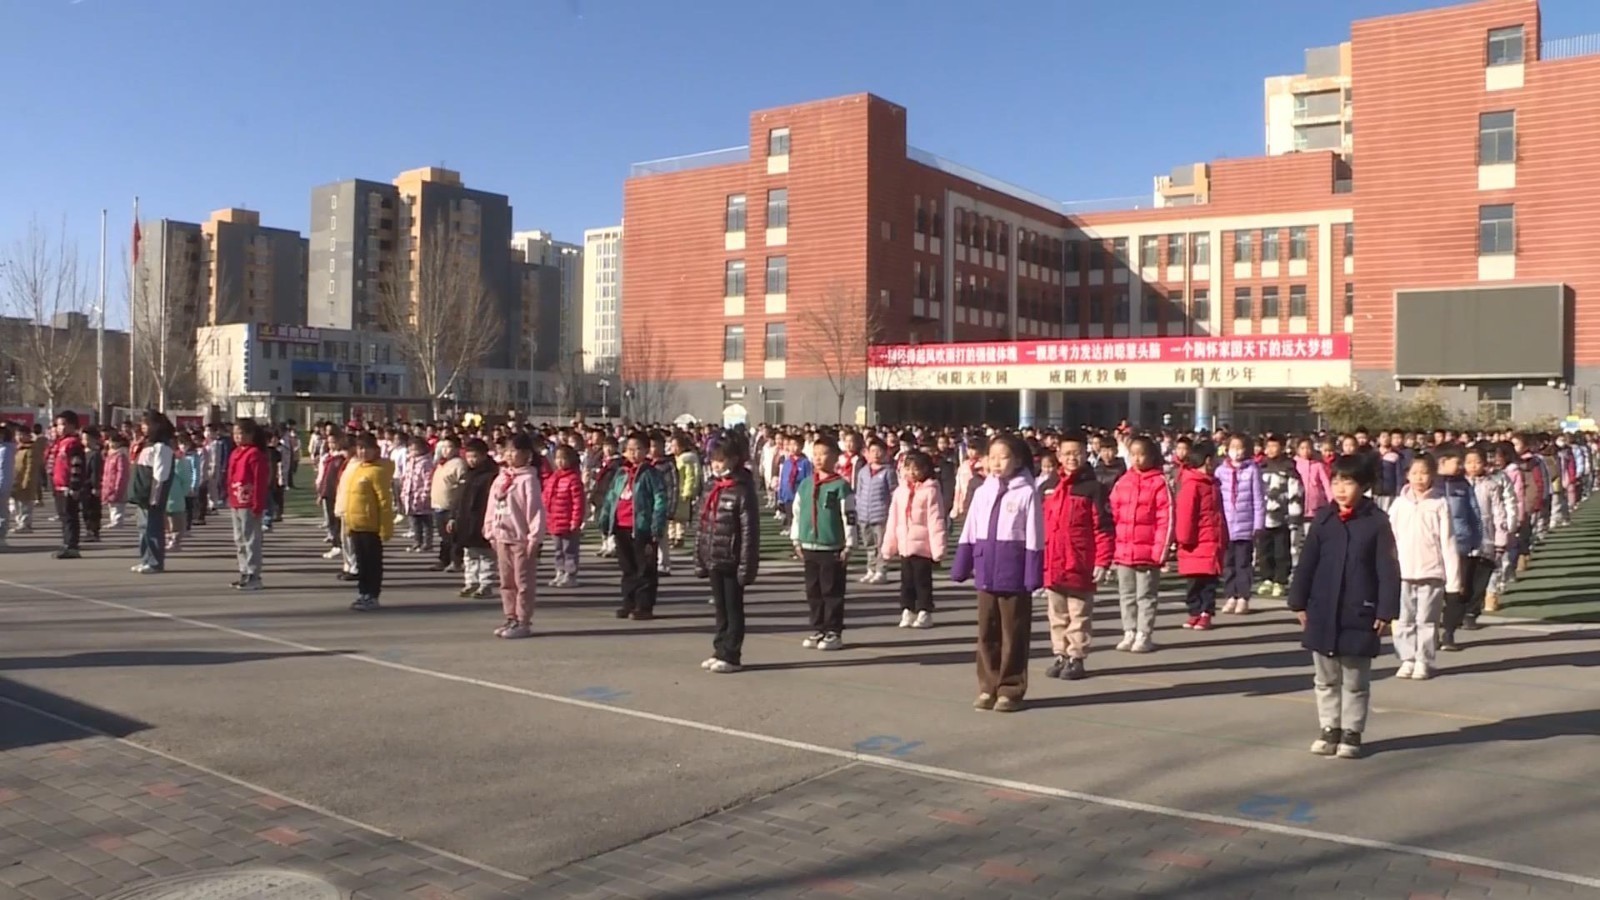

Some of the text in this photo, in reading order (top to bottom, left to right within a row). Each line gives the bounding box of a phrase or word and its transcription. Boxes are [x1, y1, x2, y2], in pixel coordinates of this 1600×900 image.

[1170, 338, 1334, 359] 一个胸怀家国天下的远大梦想
[1174, 366, 1256, 382] 育阳光少年
